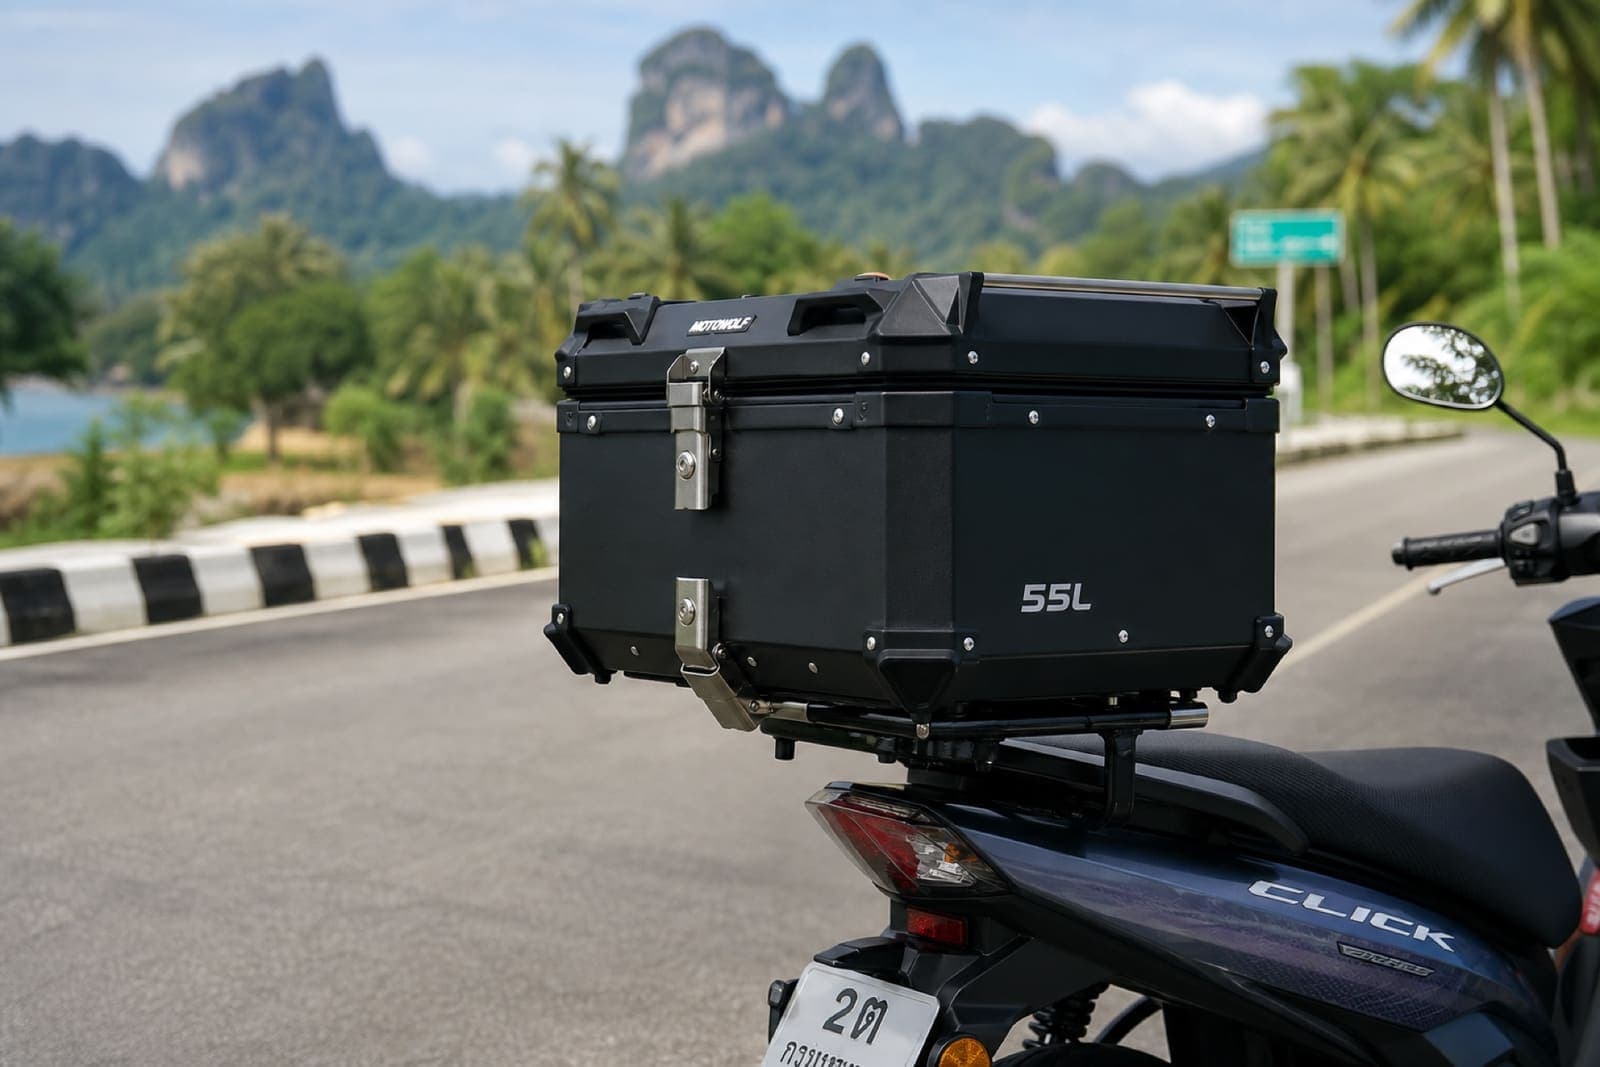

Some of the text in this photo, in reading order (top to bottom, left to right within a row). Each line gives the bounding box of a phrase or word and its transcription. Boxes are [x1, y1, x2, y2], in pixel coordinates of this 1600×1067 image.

[687, 317, 752, 333] MOTOWOLF
[1021, 583, 1092, 612] 55L
[1249, 880, 1455, 952] CLICK
